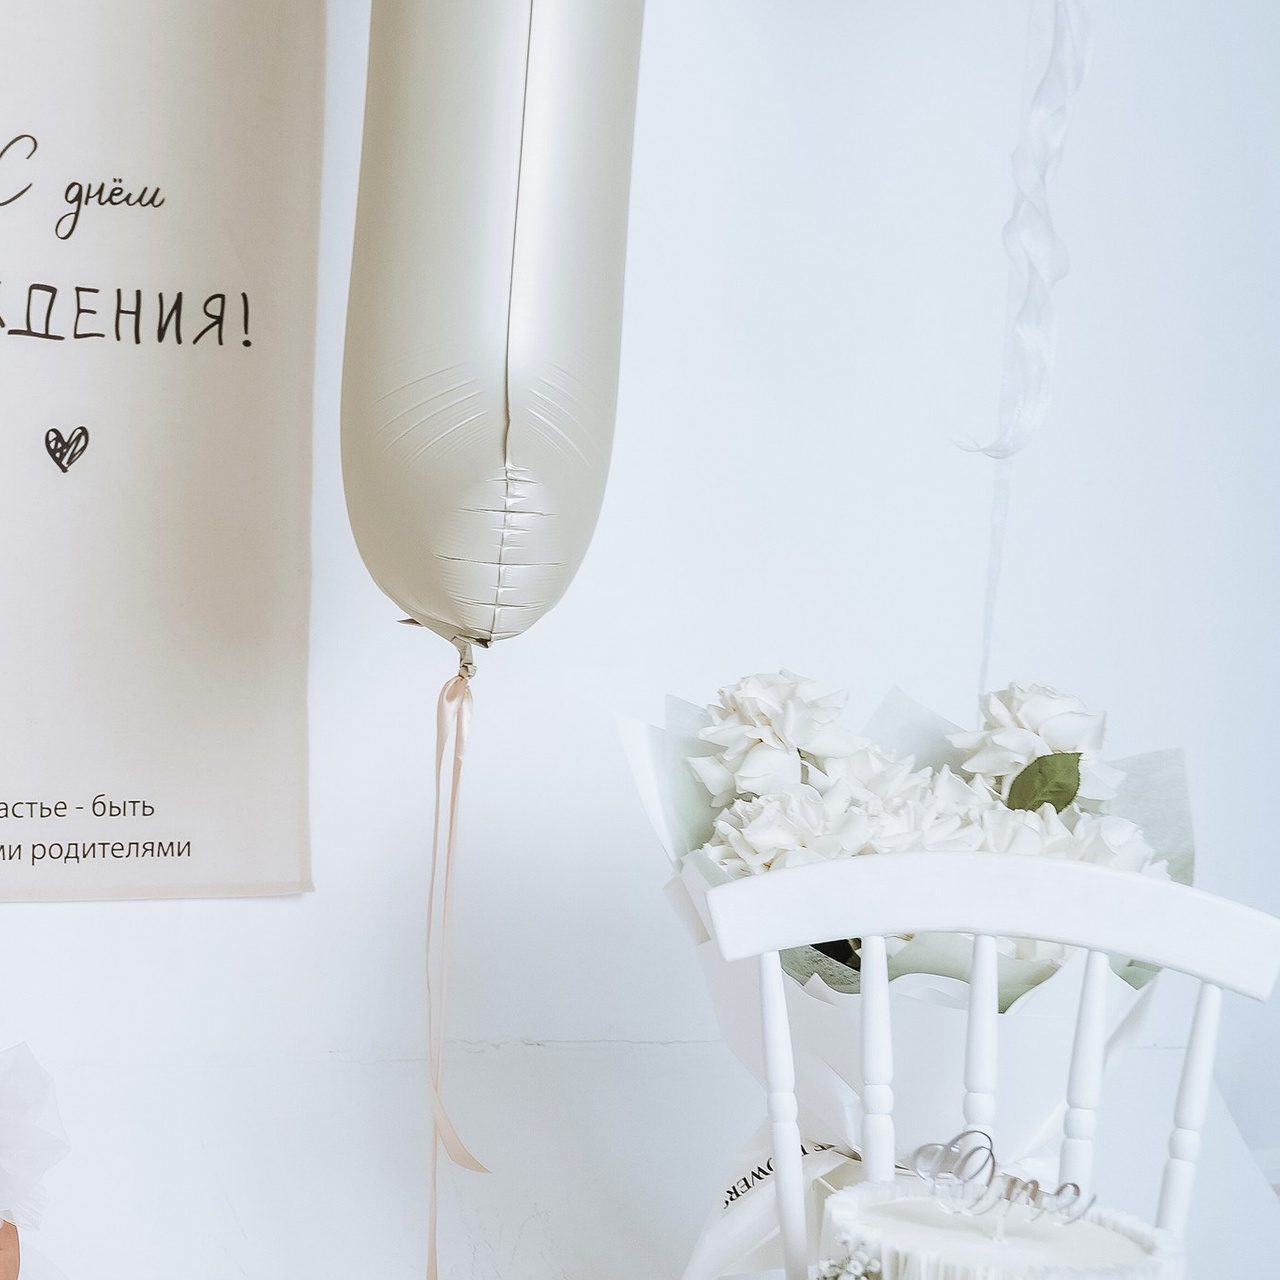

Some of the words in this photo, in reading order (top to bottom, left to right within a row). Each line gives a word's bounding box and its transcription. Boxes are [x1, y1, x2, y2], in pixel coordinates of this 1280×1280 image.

[54, 177, 166, 241] днём
[91, 793, 155, 818] быть
[31, 839, 192, 867] родителями
